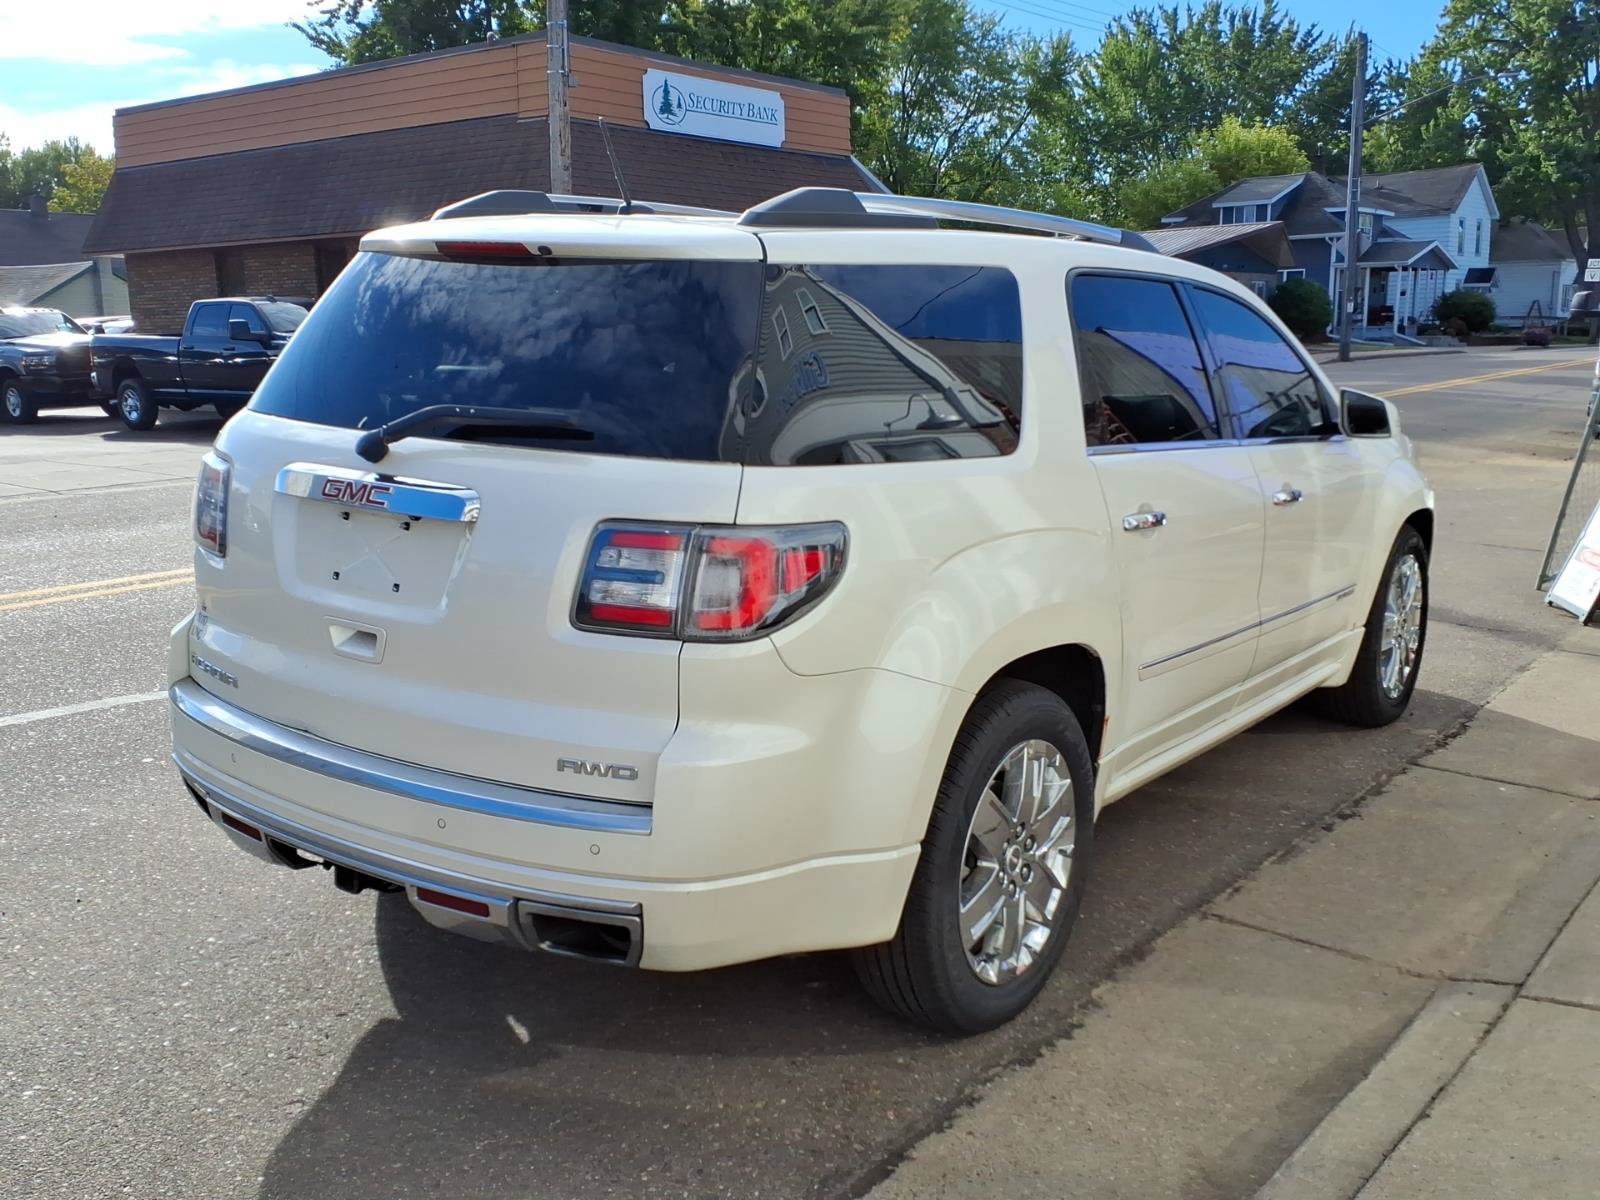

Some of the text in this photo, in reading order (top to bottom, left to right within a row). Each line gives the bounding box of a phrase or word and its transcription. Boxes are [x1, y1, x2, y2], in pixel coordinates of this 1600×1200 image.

[687, 92, 779, 123] SECURITY BANK
[321, 478, 393, 508] GMC
